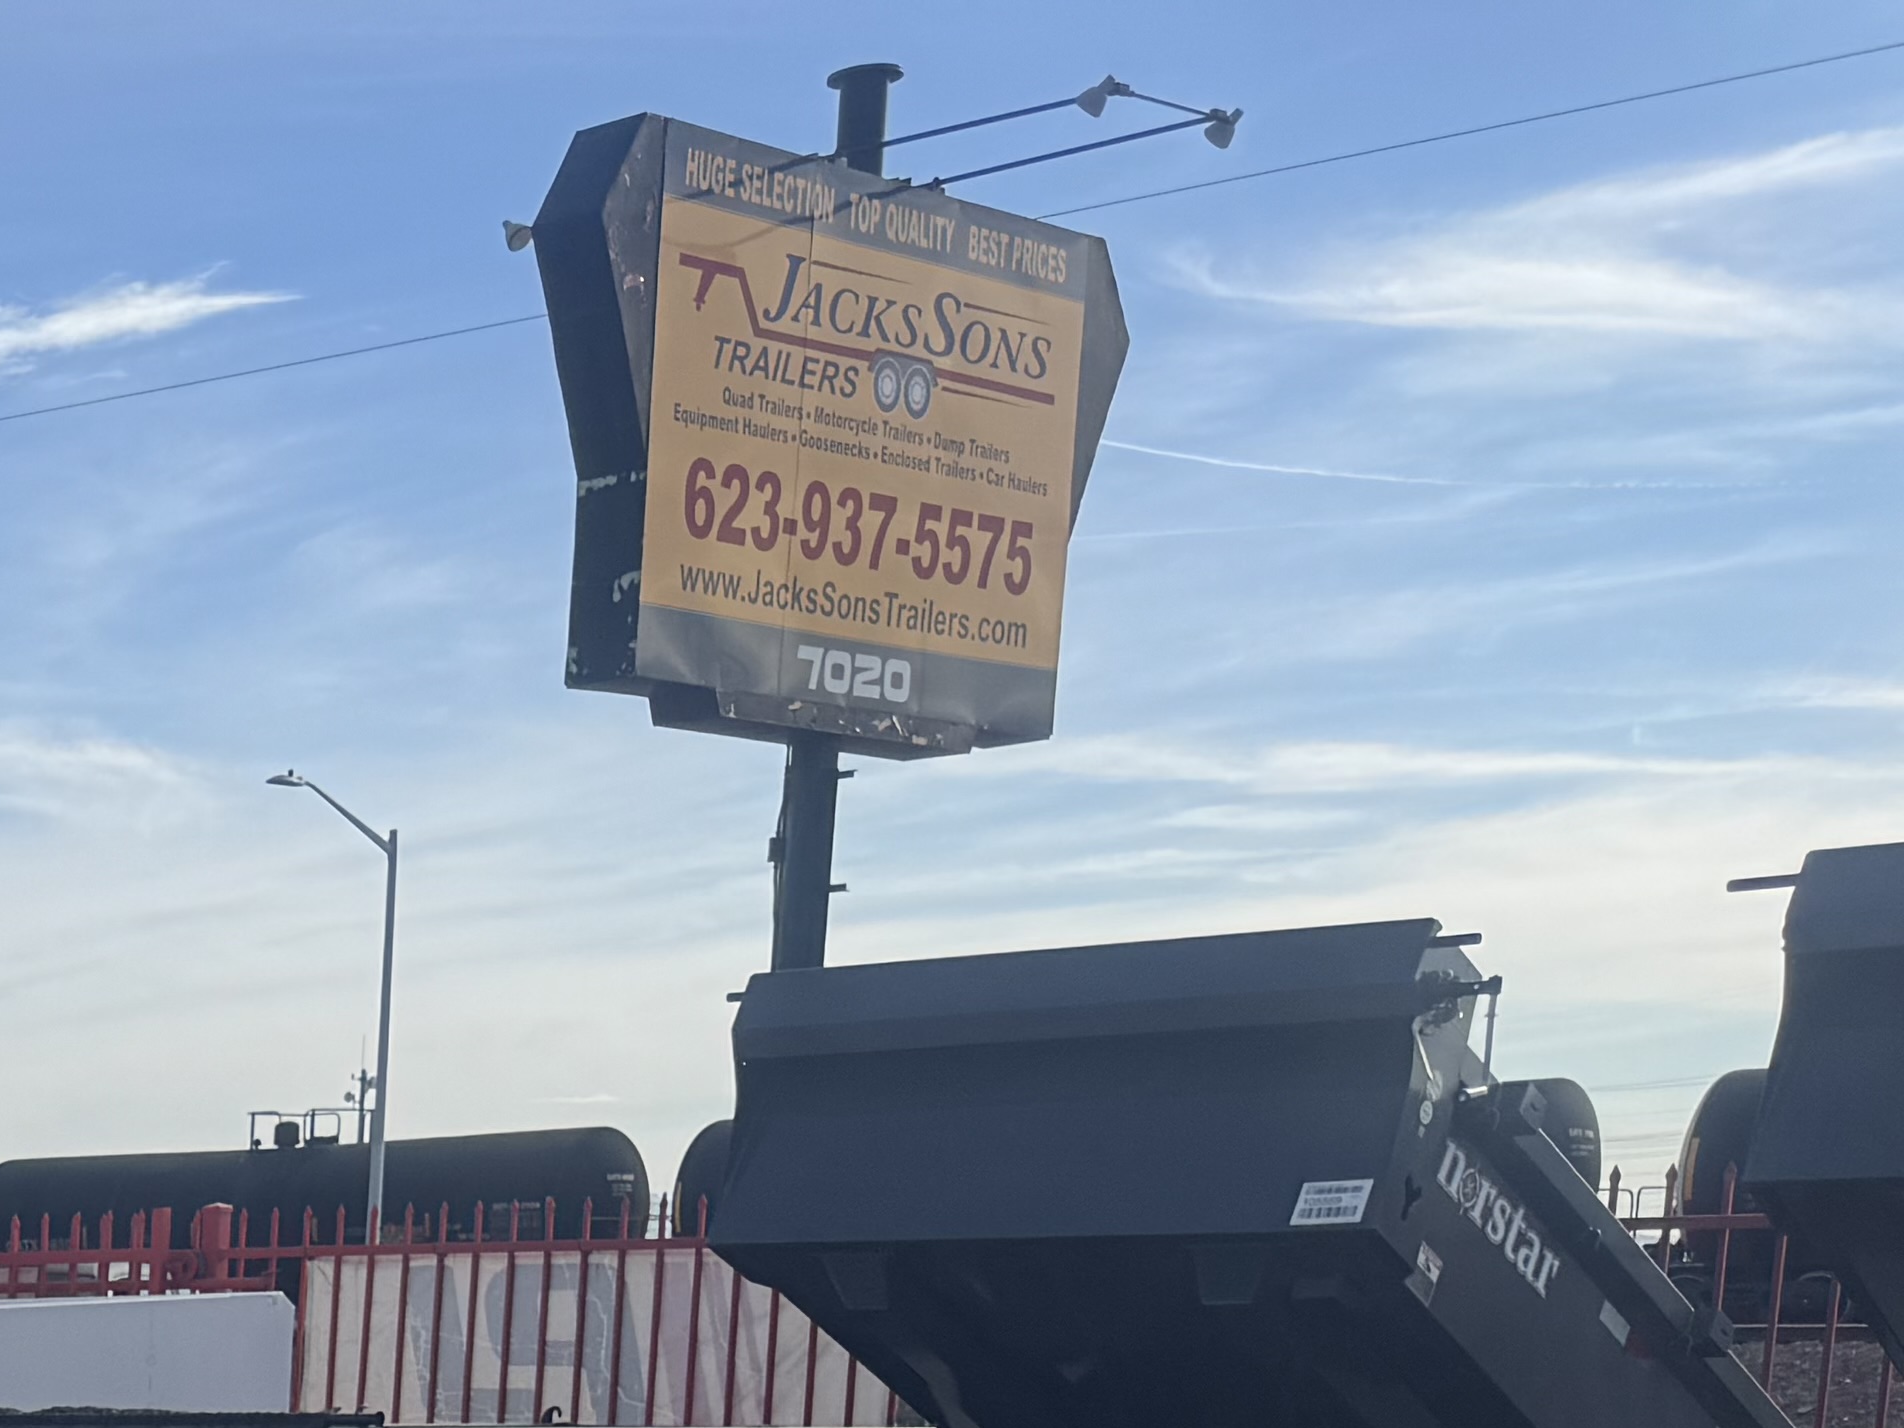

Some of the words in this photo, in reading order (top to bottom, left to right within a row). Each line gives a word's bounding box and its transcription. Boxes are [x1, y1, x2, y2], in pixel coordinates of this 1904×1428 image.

[685, 148, 736, 198] HUGE
[740, 163, 835, 223] SELECTION
[850, 192, 881, 235] TOP
[885, 203, 956, 253] QUALITY
[968, 225, 1010, 268] BEST
[1011, 237, 1067, 283] PRICES
[713, 336, 860, 399] TRAILERS
[674, 403, 739, 434] Equipment
[743, 416, 788, 444] Haulers
[799, 430, 870, 460] Goosenecks
[881, 446, 930, 473] Enclosed
[935, 457, 976, 482] Trailers
[986, 468, 1005, 488] Car
[1008, 472, 1048, 497] Haulers
[722, 386, 754, 410] Quad
[758, 394, 803, 421] Trailers
[814, 405, 878, 436] Motorcycle
[882, 420, 924, 446] Trailers
[934, 432, 965, 458] Dump
[969, 438, 1010, 464] Trailers
[684, 457, 1033, 596] 623-937-5575
[680, 564, 1028, 648] www.JacksSonsTrailers.com
[797, 644, 911, 702] 7020
